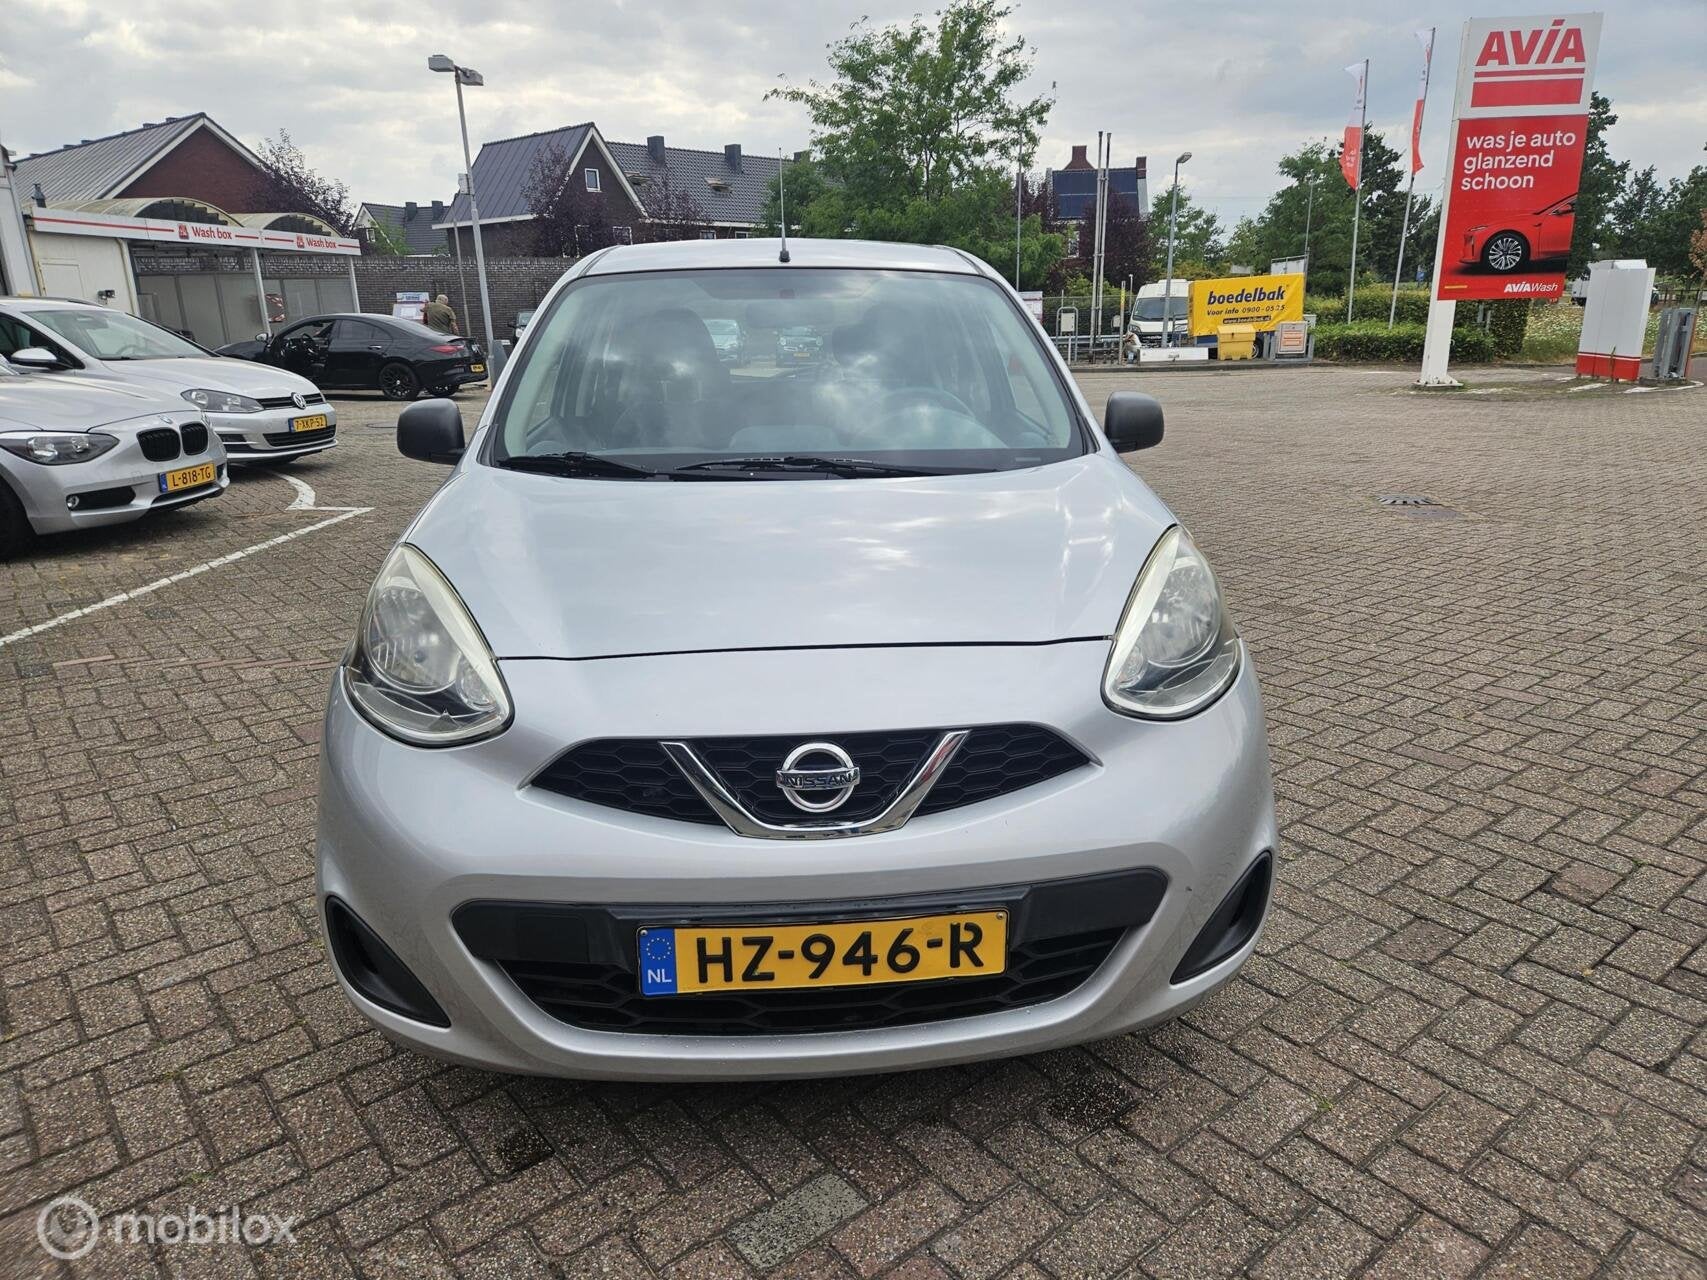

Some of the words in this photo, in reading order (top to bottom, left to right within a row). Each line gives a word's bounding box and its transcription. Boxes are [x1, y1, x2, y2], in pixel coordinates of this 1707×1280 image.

[1475, 19, 1586, 67] AVIA
[1466, 134, 1505, 149] was
[1506, 131, 1527, 152] je
[1530, 130, 1576, 147] auto
[1463, 150, 1554, 174] glanzend
[1461, 172, 1534, 190] schoon
[191, 226, 216, 238] Wash
[216, 228, 233, 240] box
[306, 237, 325, 248] Wash
[325, 239, 337, 249] box
[1208, 286, 1285, 305] boedelbak
[1225, 307, 1239, 315] info
[172, 465, 211, 487] L-818-TG
[786, 773, 853, 788] NISSAN
[647, 968, 672, 984] NL
[696, 922, 984, 984] HZ-946-R
